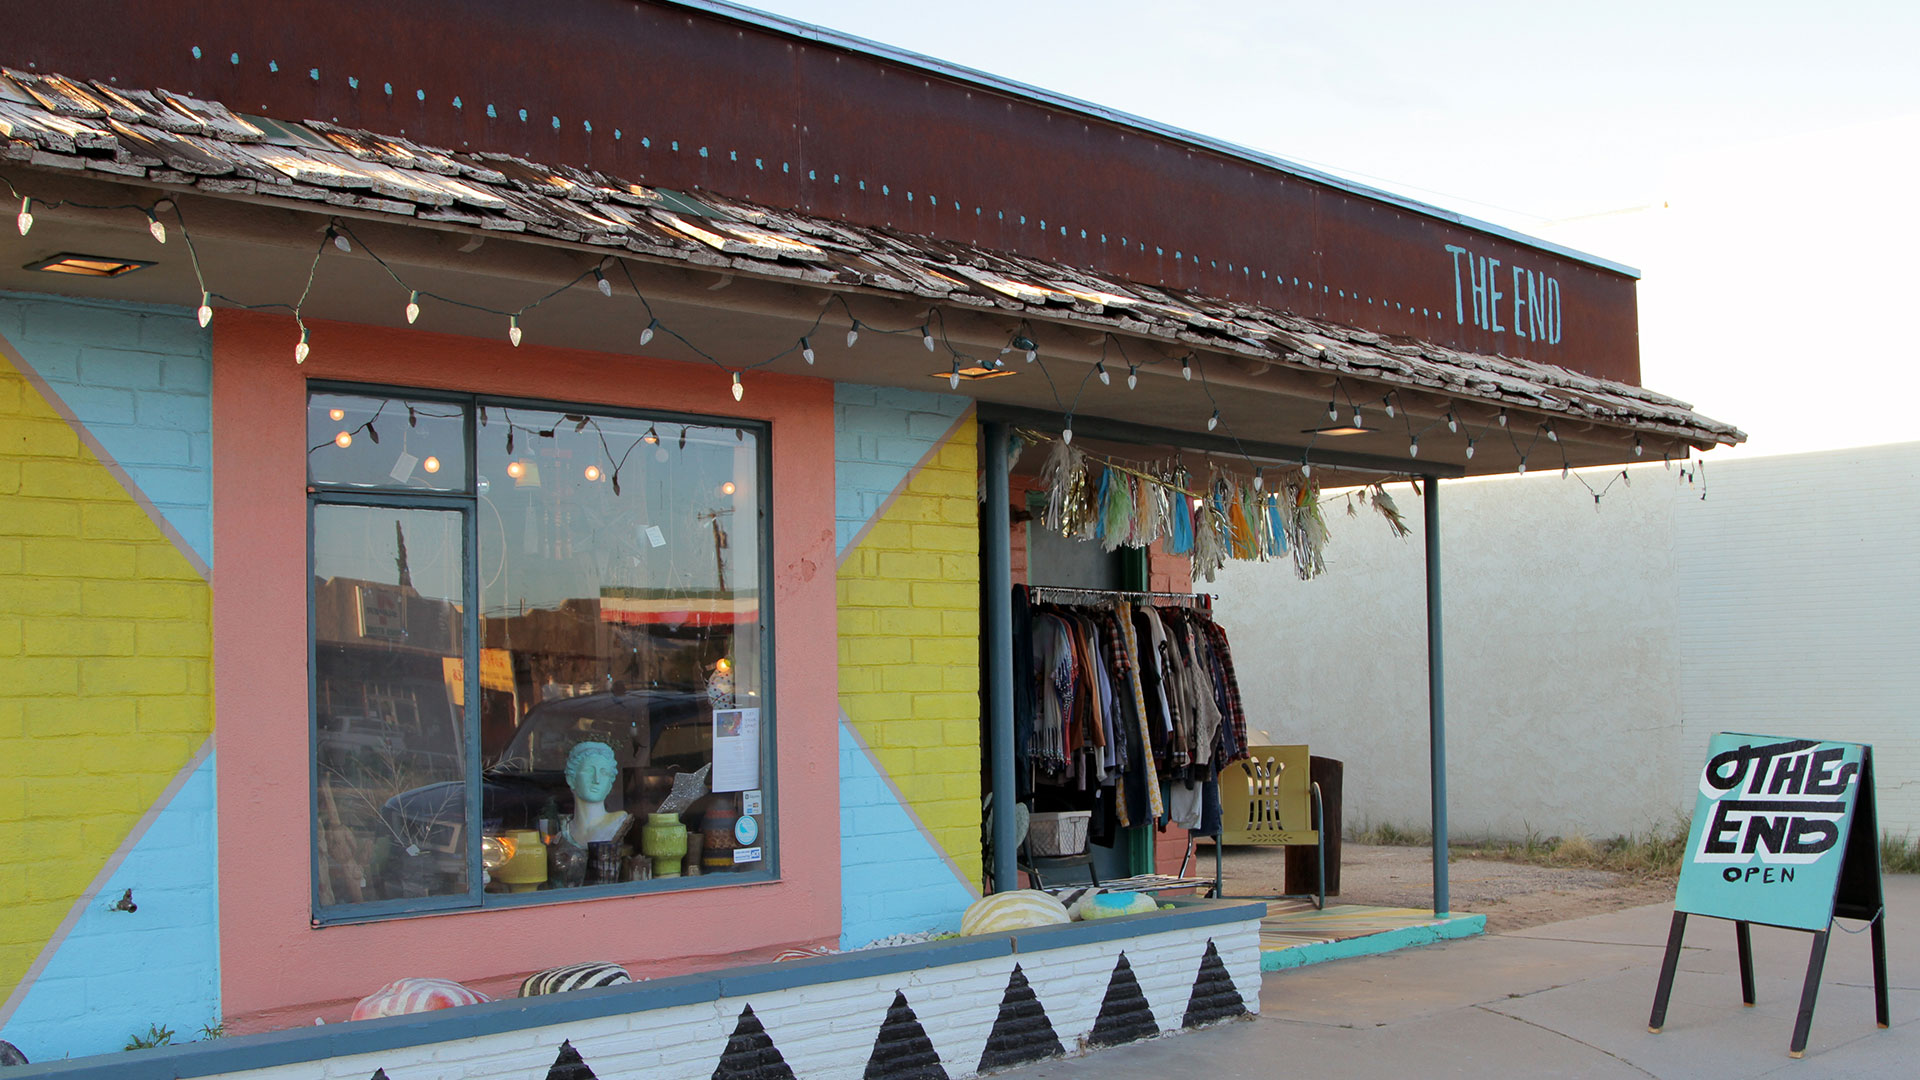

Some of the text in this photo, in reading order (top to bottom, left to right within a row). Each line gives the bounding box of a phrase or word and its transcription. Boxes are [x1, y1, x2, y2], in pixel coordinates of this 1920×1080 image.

[1445, 244, 1561, 344] THE END
[1705, 740, 1859, 795] THE
[1703, 800, 1846, 854] END
[1722, 867, 1795, 884] OPEN
